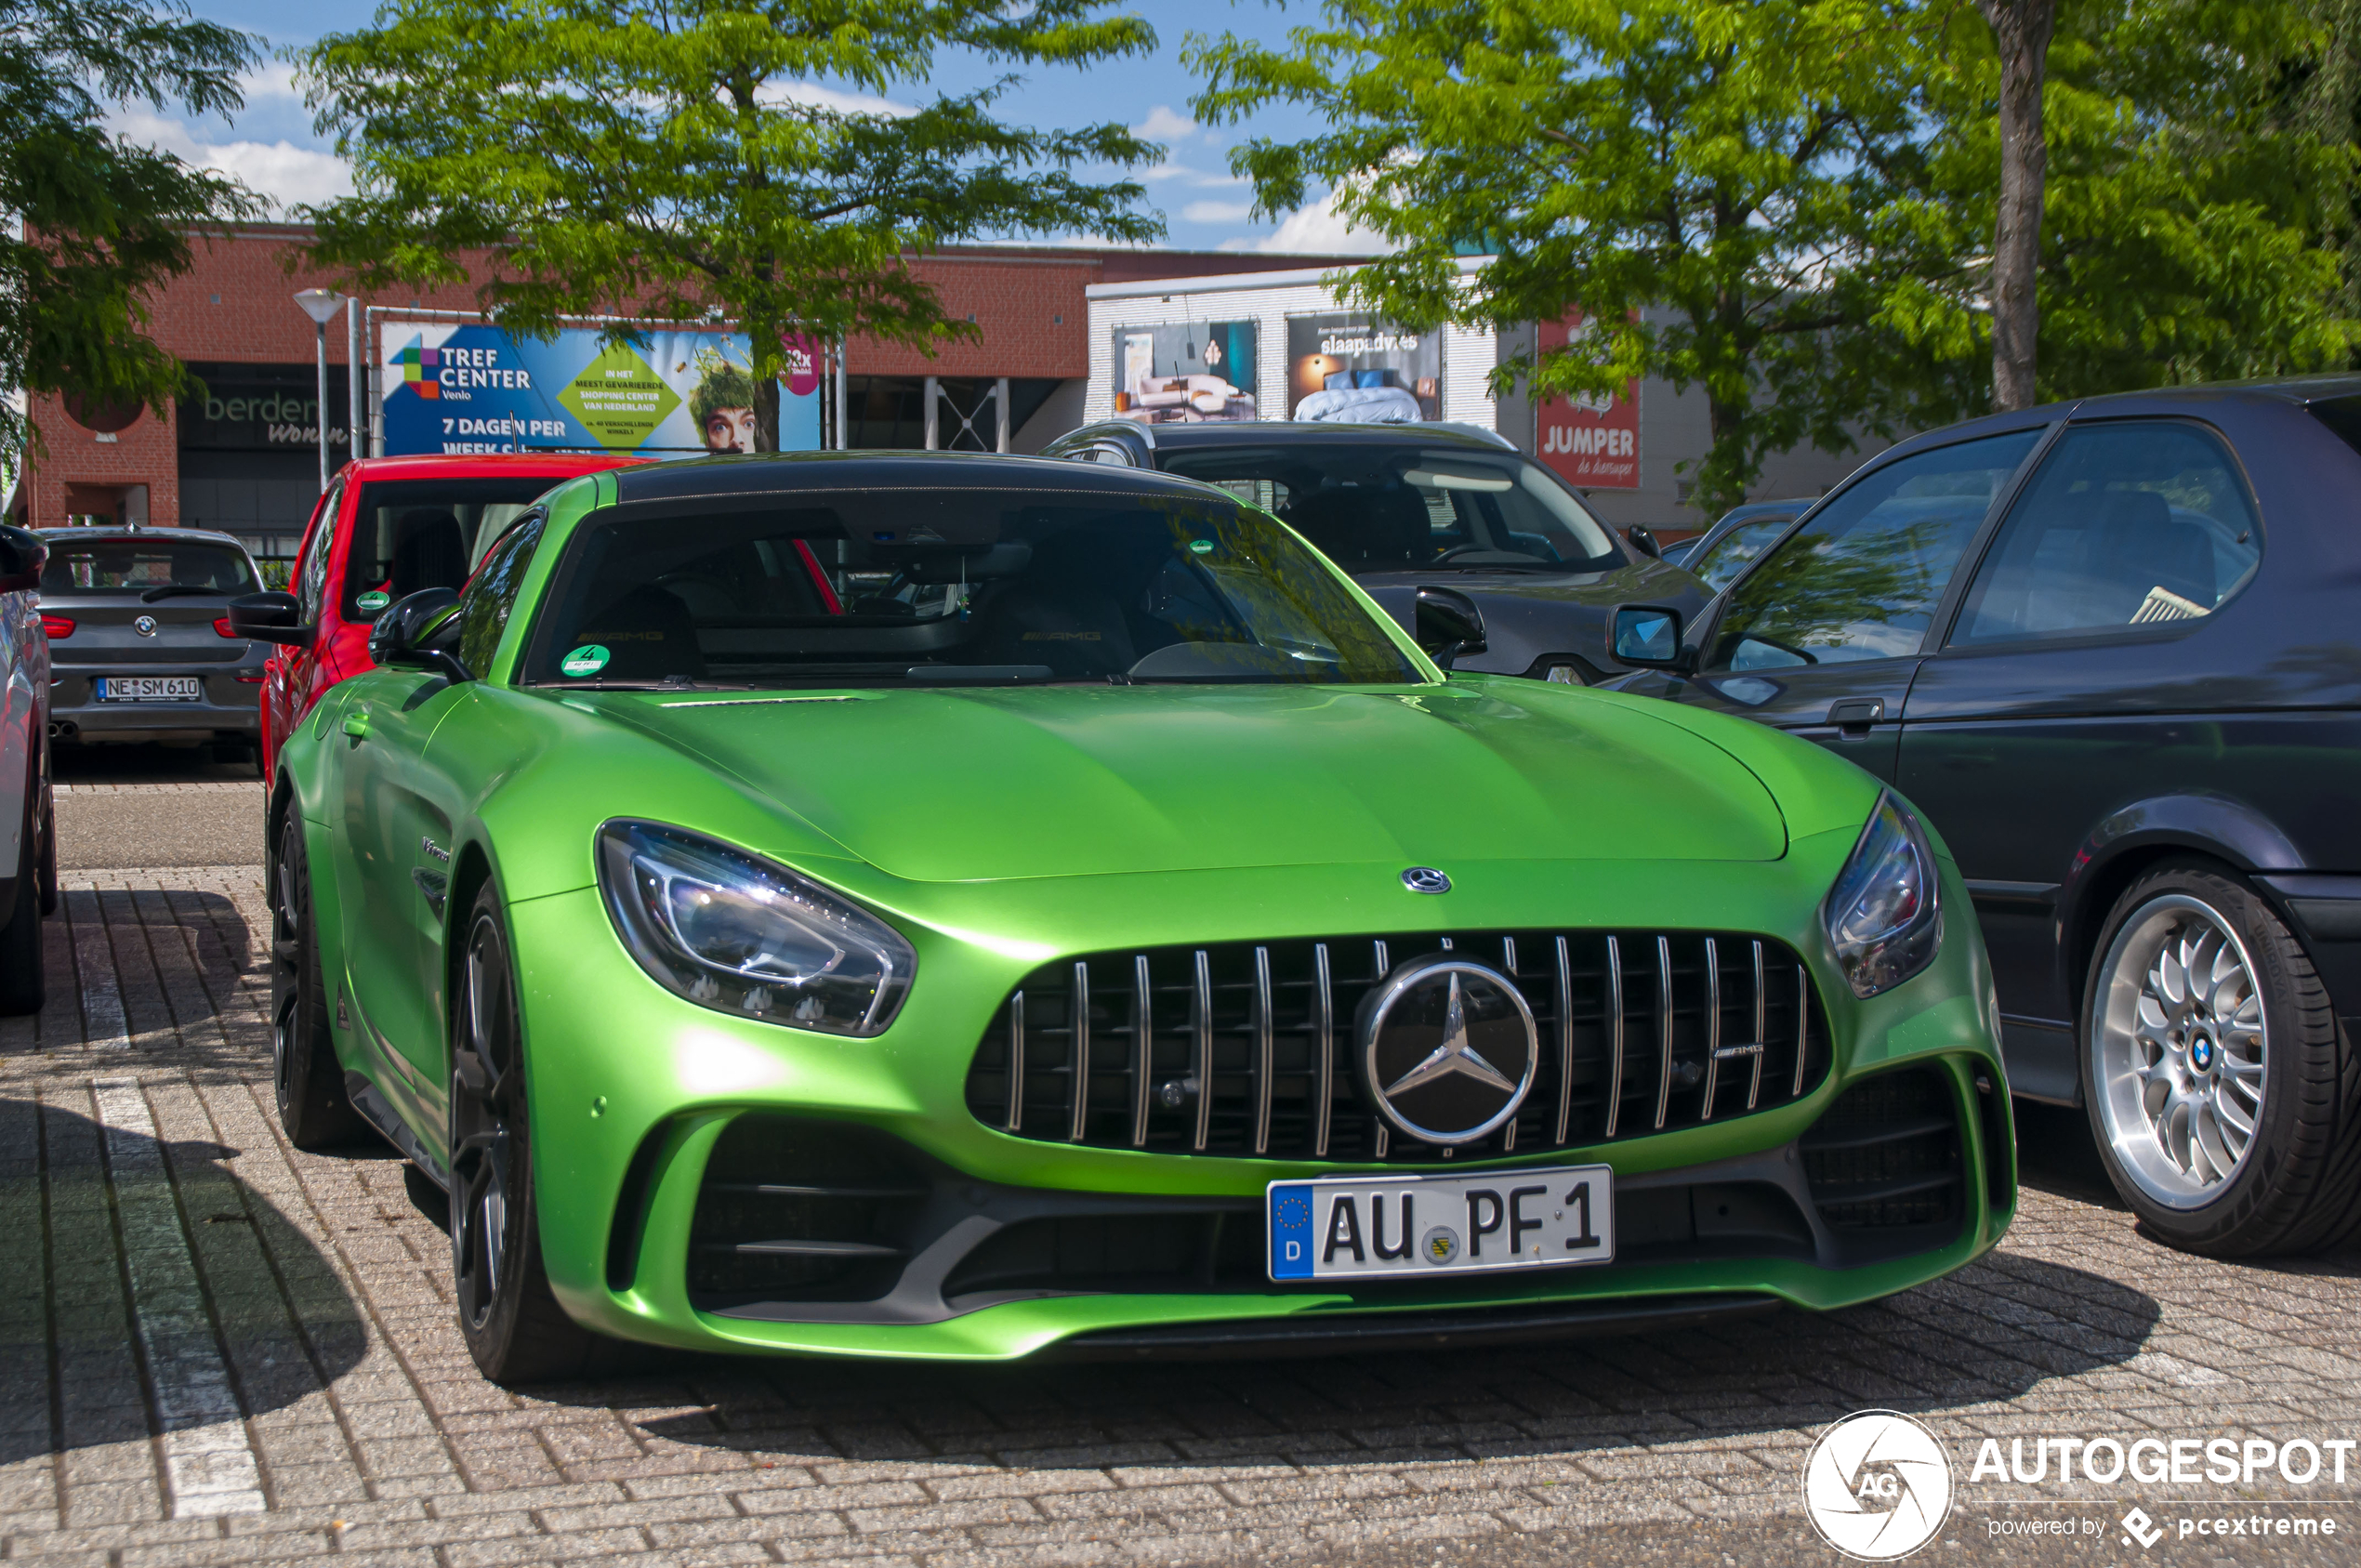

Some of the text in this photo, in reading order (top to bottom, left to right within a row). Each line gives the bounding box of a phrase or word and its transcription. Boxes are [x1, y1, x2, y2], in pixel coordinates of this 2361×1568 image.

[441, 348, 498, 368] TREF
[439, 368, 531, 389] CENTER
[605, 370, 634, 378] IN HET
[575, 380, 664, 389] MEEST GEVARIEERDE
[442, 389, 472, 401] Venlo
[580, 390, 660, 402] SHOPPING CENTER
[204, 390, 319, 422] berden
[584, 402, 656, 412] VAN NEDERLAND
[442, 418, 566, 437] 7 DAGEN PER
[1543, 425, 1634, 457] JUMPER
[1576, 456, 1590, 475] de
[605, 630, 664, 641] AMG
[1047, 631, 1101, 641] AMG
[581, 646, 596, 661] 4
[109, 679, 198, 695] NE SM 610
[1731, 1044, 1764, 1055] AMG
[1322, 1180, 1601, 1263] AU PF 1
[1286, 1240, 1300, 1262] D
